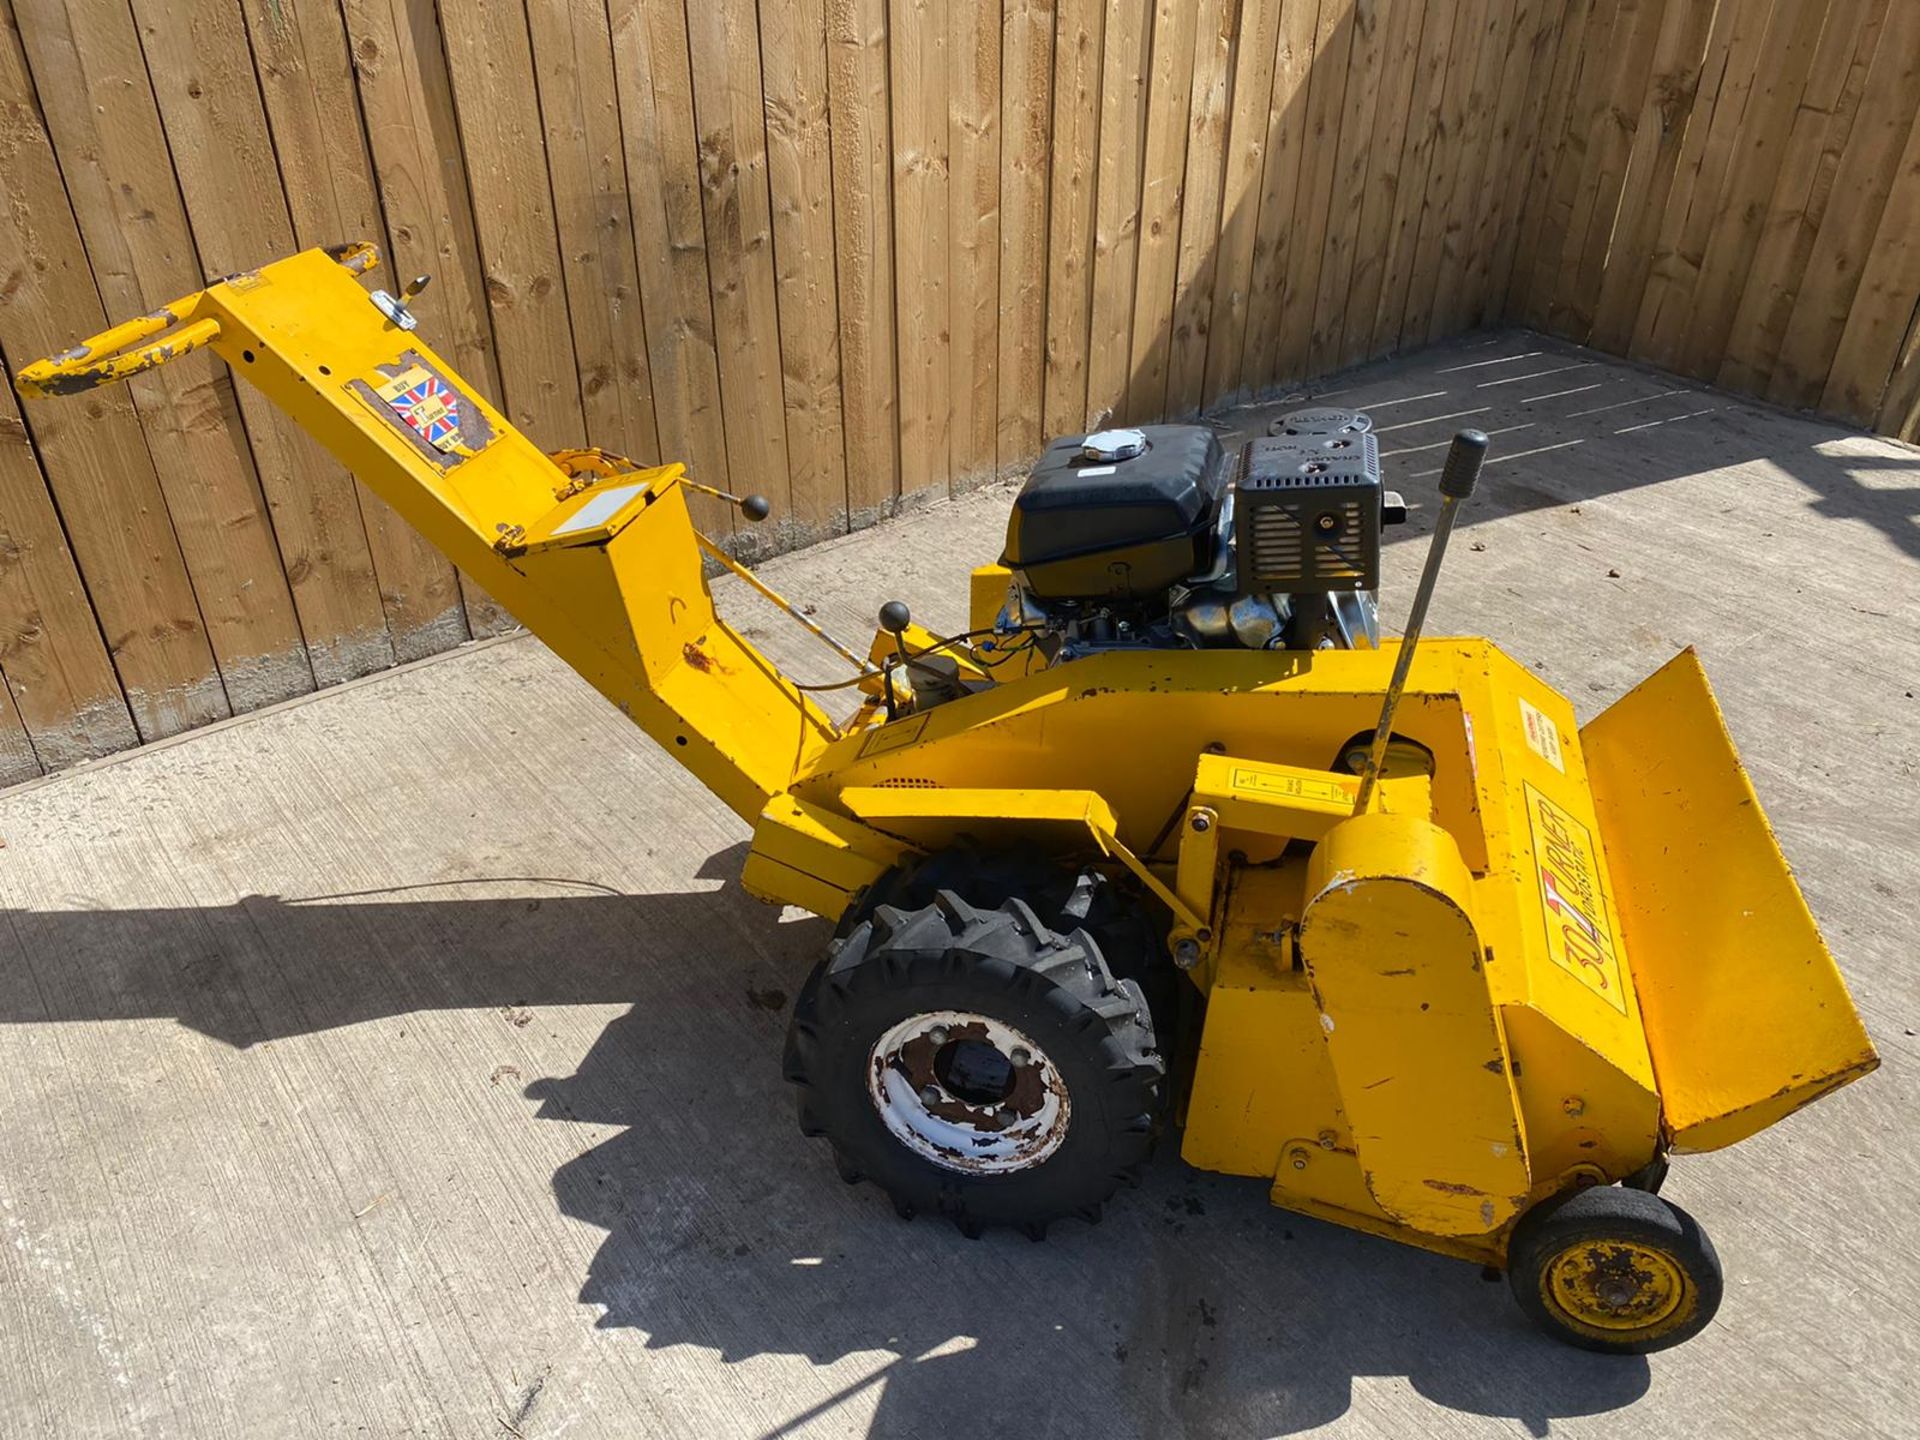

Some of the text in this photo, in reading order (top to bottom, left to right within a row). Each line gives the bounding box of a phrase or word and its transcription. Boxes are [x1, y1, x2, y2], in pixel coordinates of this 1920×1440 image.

[392, 380, 410, 393] BUY
[1538, 799, 1608, 990] 30 TURNER
